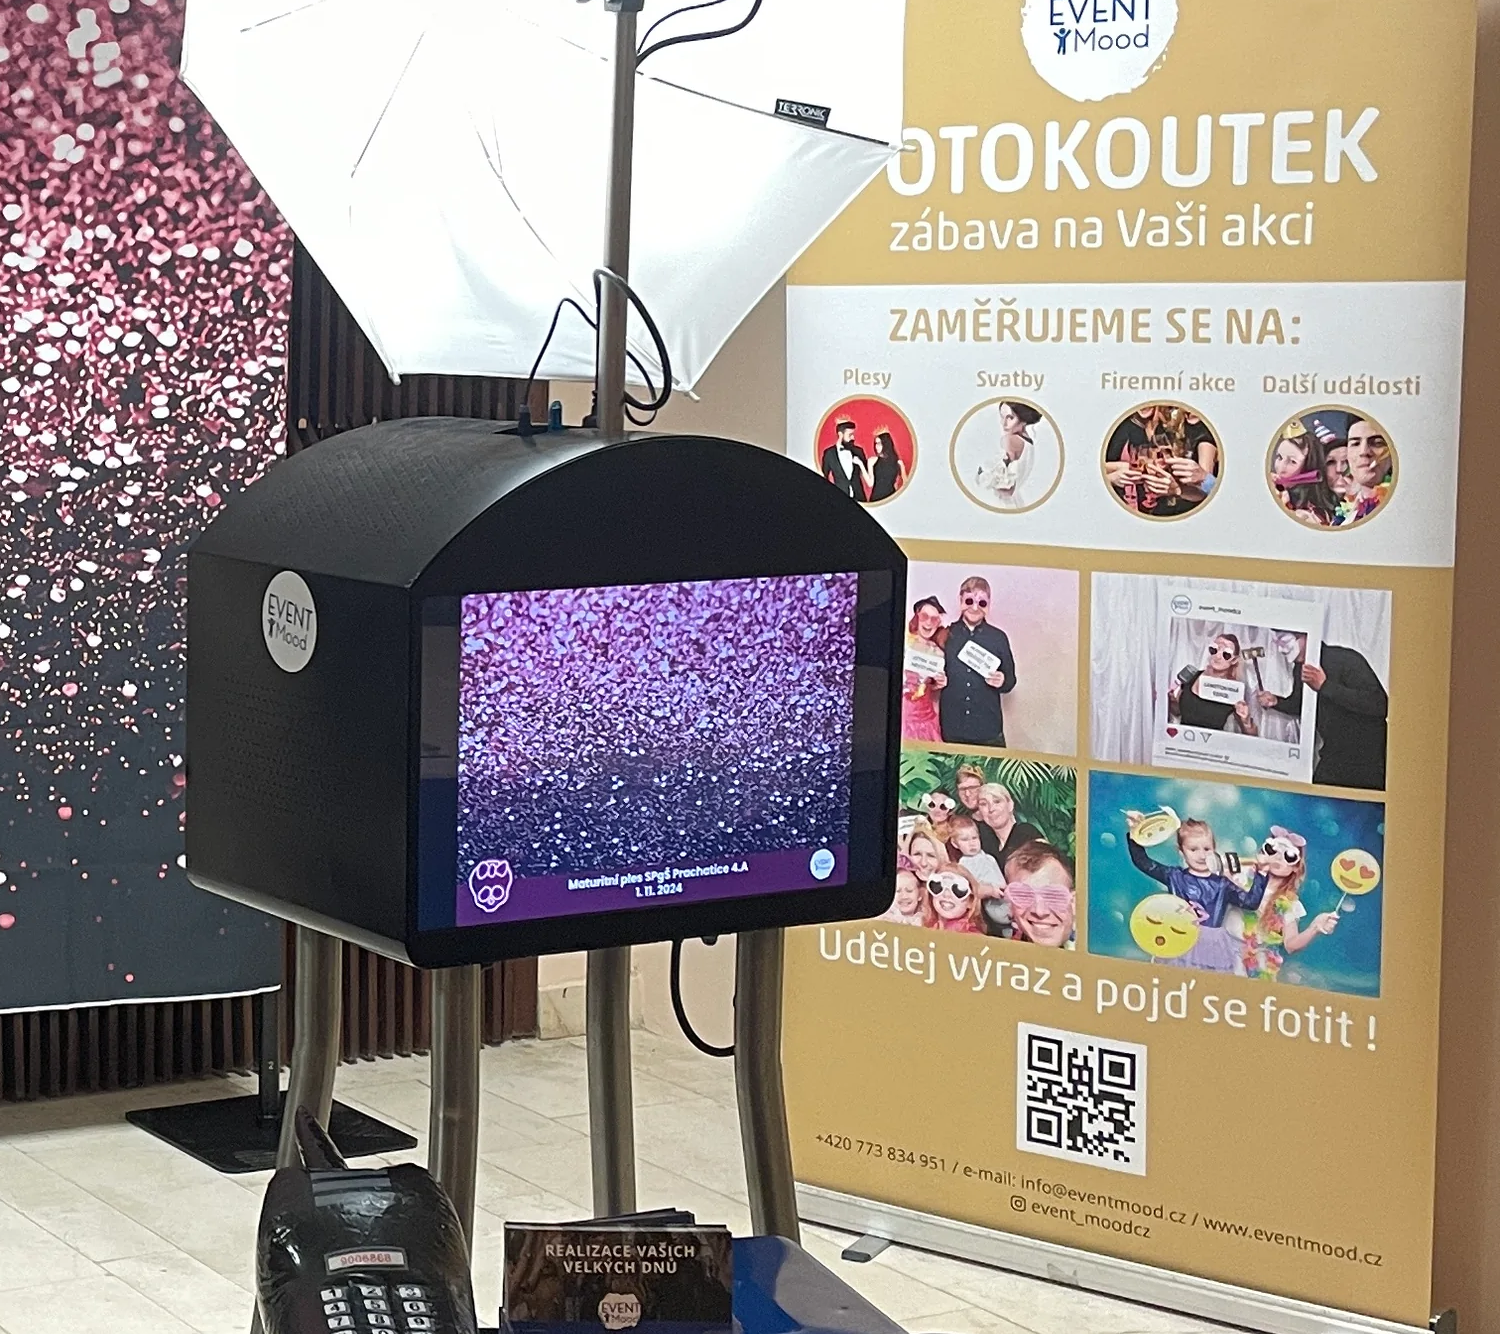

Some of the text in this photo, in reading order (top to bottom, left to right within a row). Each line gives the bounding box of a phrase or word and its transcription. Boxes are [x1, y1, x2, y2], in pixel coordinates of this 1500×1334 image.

[1074, 24, 1150, 54] Mood
[889, 201, 1315, 252] zábava na Vaši akci
[889, 297, 1300, 345] ZAMĚŘUJEME SE NA:
[843, 368, 892, 389] Plesy
[976, 370, 1044, 391] Svatby
[1100, 371, 1236, 392] Firemní akce
[1263, 372, 1421, 395] Další události
[268, 593, 313, 632] EVENT
[275, 622, 307, 651] Mood
[567, 874, 619, 890] Maturitní
[672, 863, 729, 880] Prachatice
[731, 861, 749, 873] 4.A
[657, 882, 683, 895] 2024
[819, 927, 1376, 1051] Udělej výraz a pojď se fotit !
[815, 1134, 851, 1151] +420
[856, 1140, 883, 1157] 773
[887, 1147, 915, 1165] 834
[920, 1154, 946, 1172] 951
[963, 1166, 1016, 1188] e-mail:
[1021, 1174, 1186, 1225] info@eventmood.cz
[1203, 1217, 1383, 1267] www.eventmood.cz
[1031, 1200, 1151, 1238] event_moodcz
[545, 1242, 695, 1258] REALIZACE VAŠICH
[563, 1257, 678, 1274] VELKÝCH DNŮ
[601, 1302, 640, 1314] EVENT
